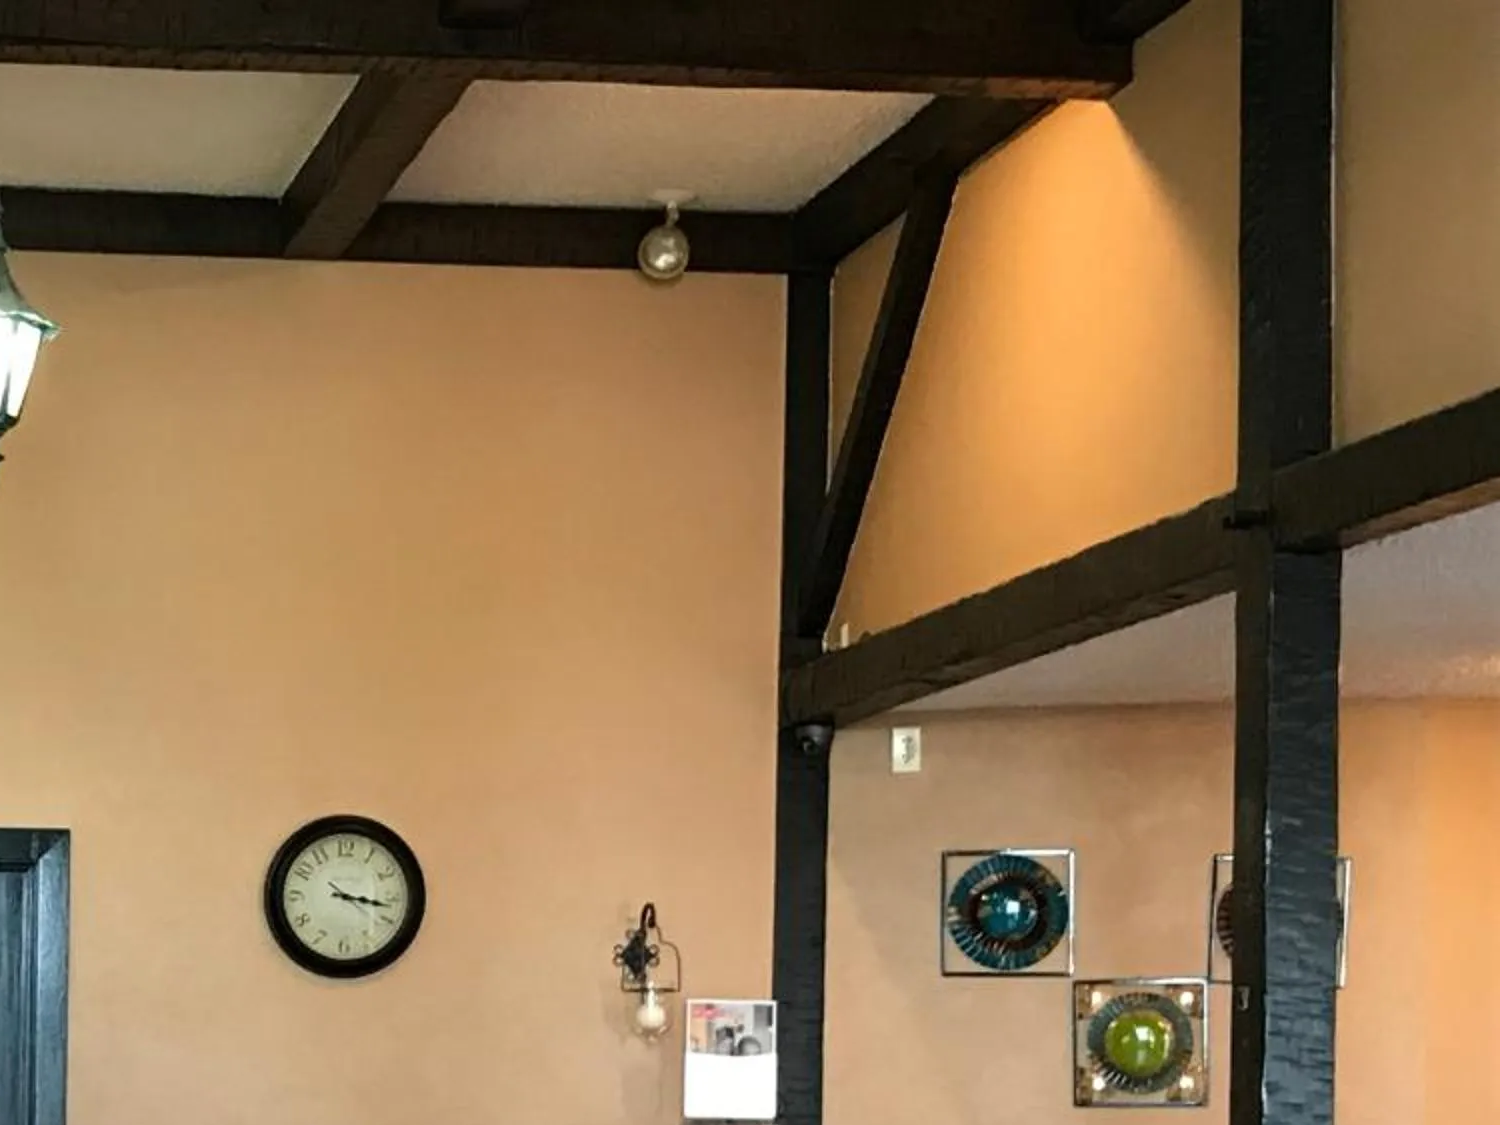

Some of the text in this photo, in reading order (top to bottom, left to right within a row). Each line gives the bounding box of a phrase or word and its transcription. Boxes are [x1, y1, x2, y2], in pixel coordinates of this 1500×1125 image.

[337, 839, 355, 858] 12
[377, 864, 396, 882] 2
[294, 912, 311, 928] 8
[312, 929, 328, 945] 7
